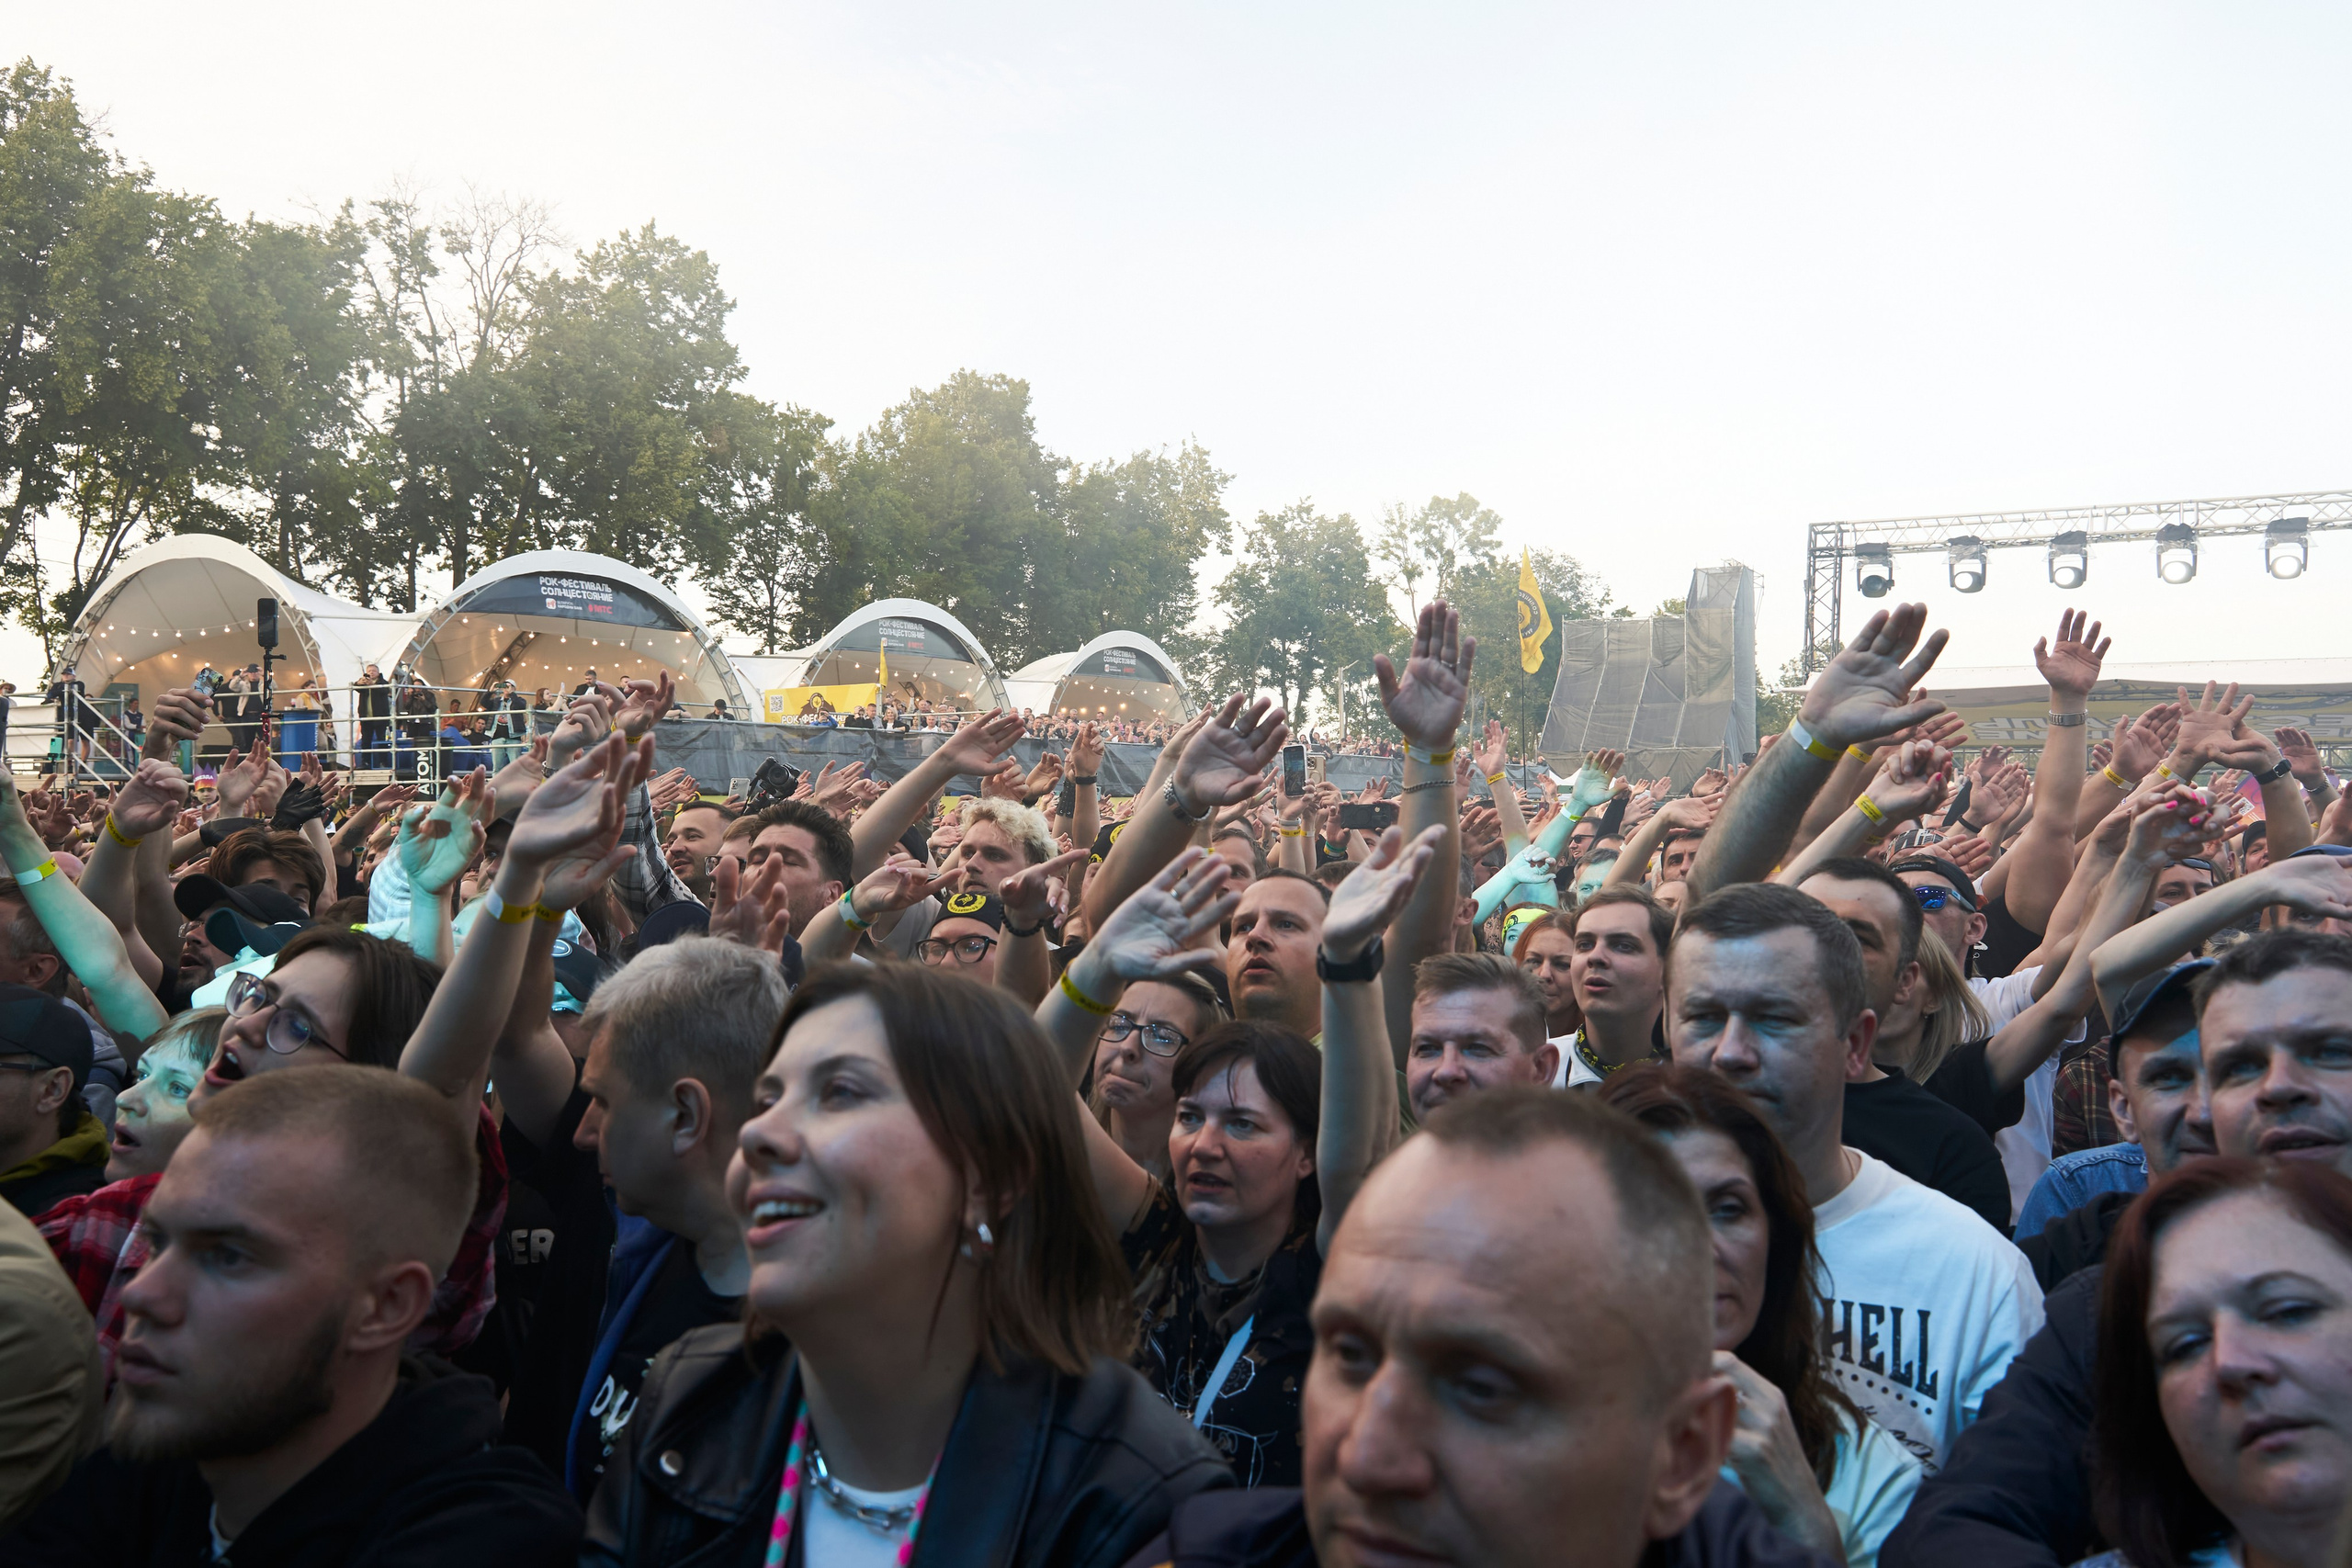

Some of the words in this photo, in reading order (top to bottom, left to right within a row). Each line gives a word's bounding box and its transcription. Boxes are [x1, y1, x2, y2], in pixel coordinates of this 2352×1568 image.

[539, 576, 612, 592] РОК-ФЕСТИВАЛЬ
[540, 586, 614, 602] СОЛНЦЕСТОЯНИЕ
[878, 619, 924, 631] РОК-ФЕСТИВАЛЬ
[878, 627, 925, 639] СОЛНЦЕСТОЯНИЕ
[506, 1228, 555, 1265] ER
